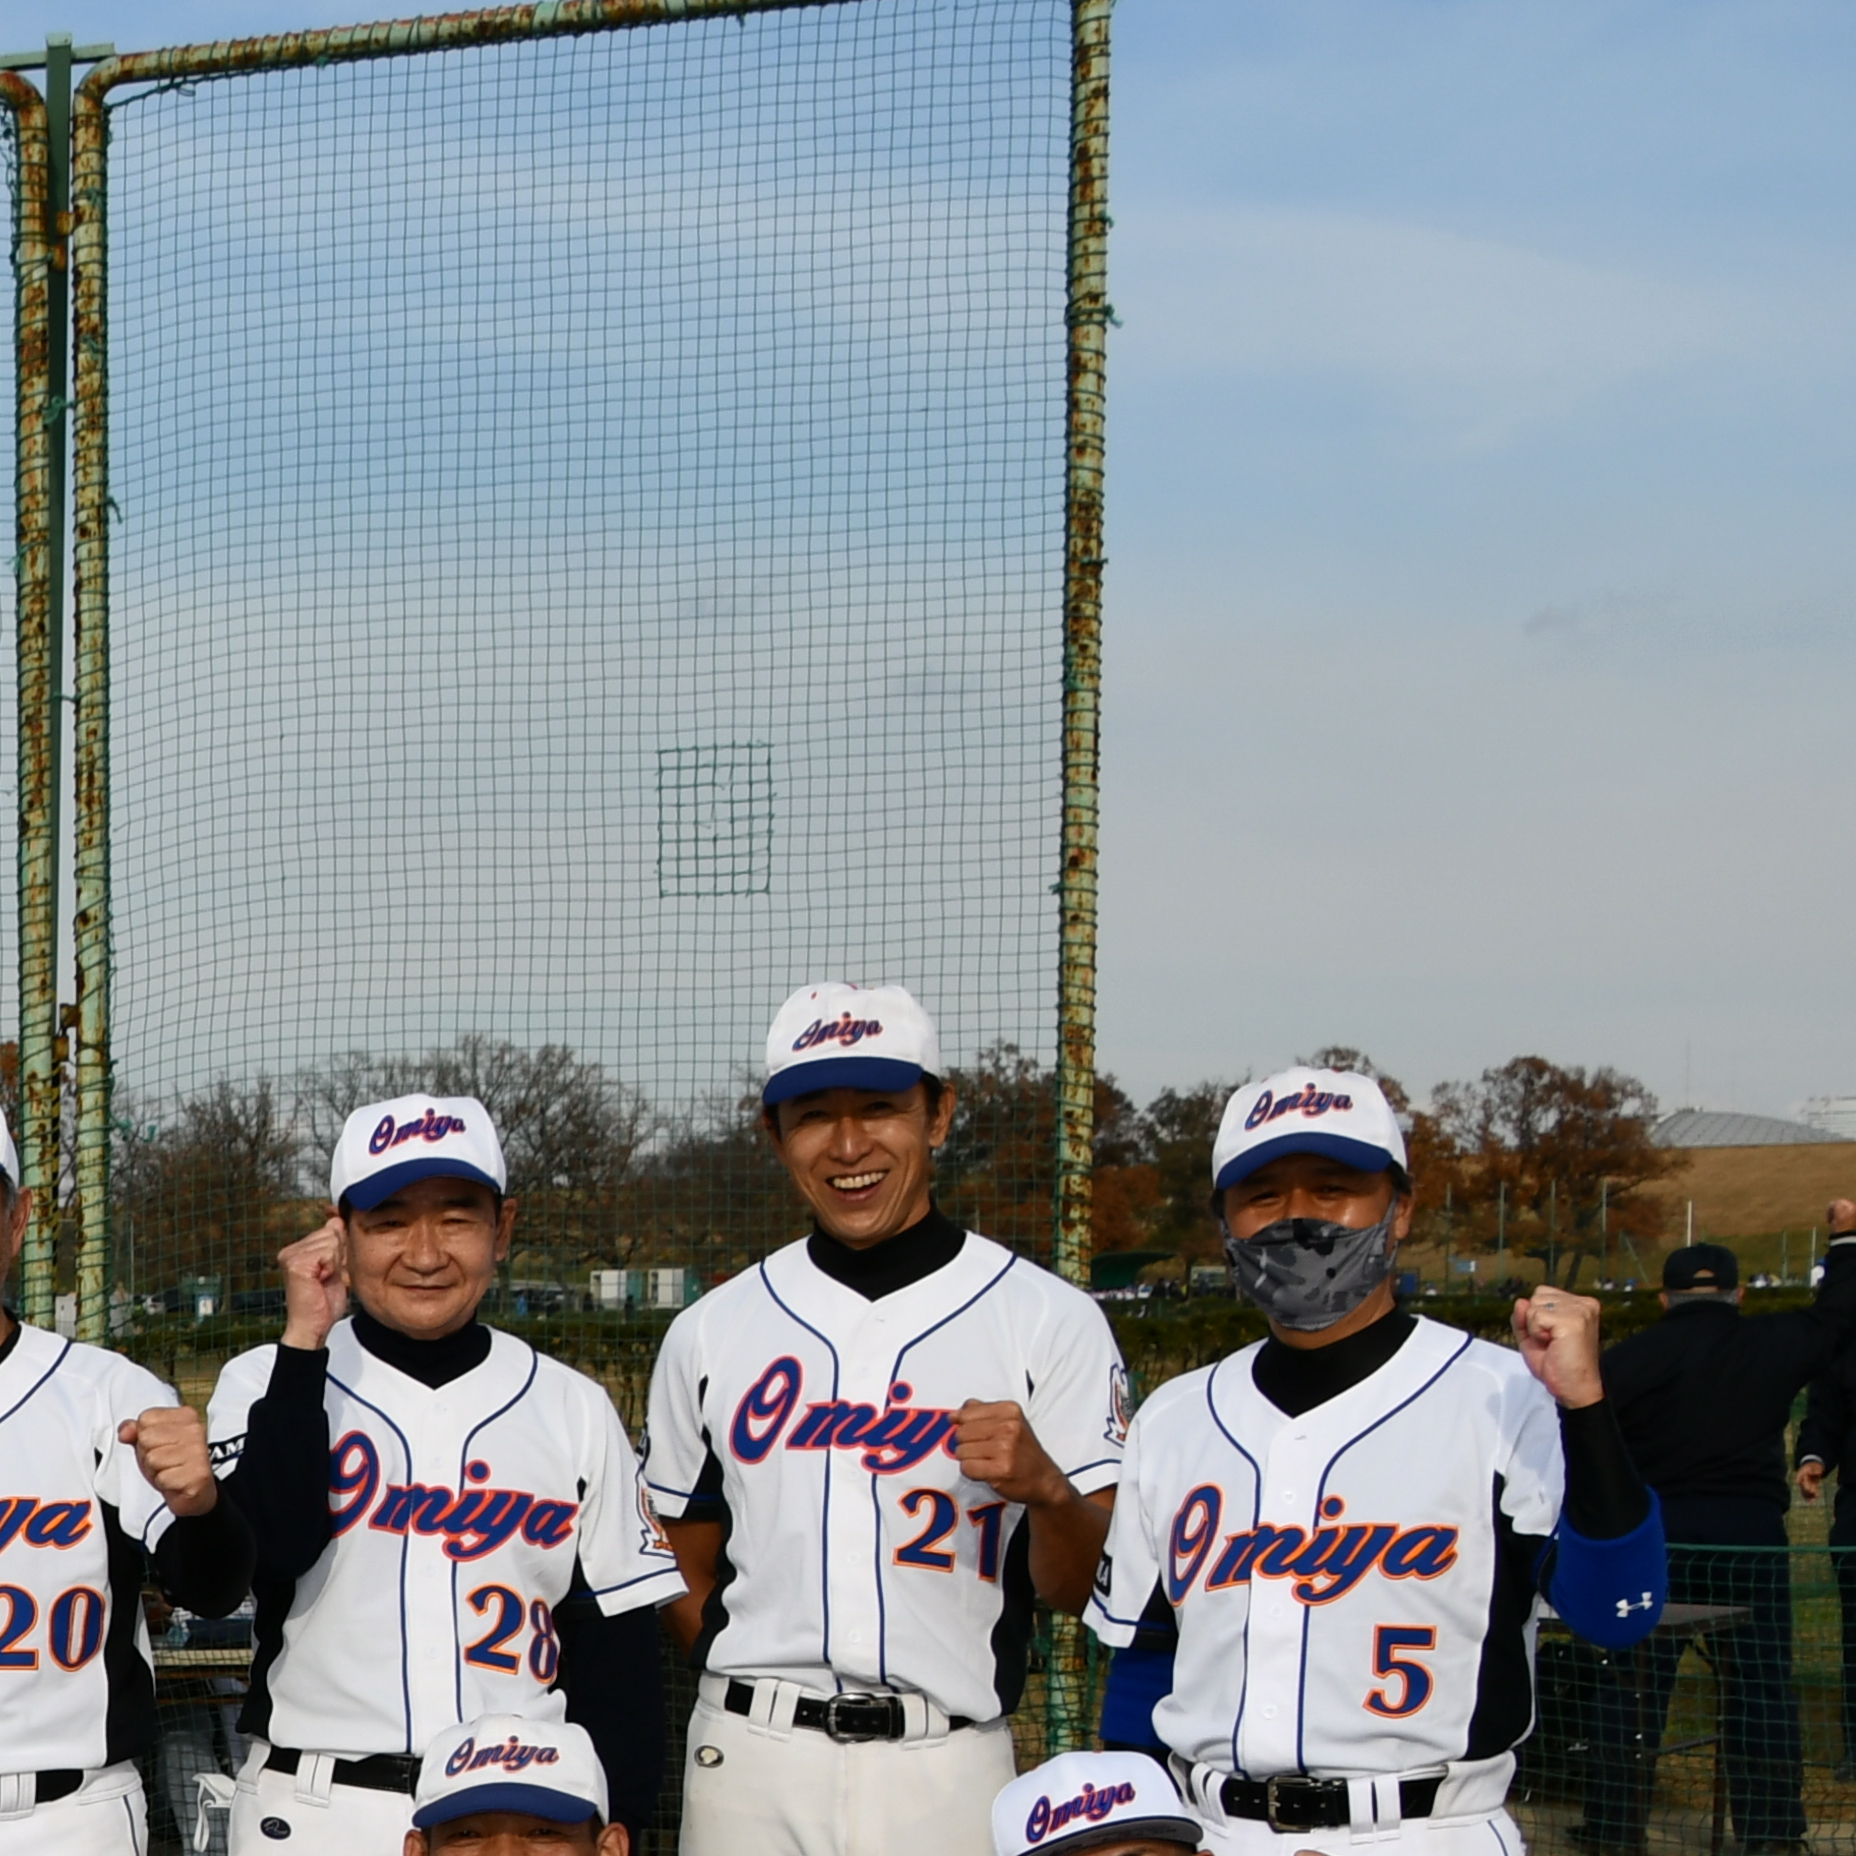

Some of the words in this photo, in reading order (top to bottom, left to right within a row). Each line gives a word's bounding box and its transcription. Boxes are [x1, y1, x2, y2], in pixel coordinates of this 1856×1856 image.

[791, 1011, 884, 1054] Omiya
[367, 1109, 466, 1156] Omiya
[1245, 1083, 1354, 1132] Omiya
[328, 1429, 579, 1562] Omiya
[892, 1486, 1006, 1583] 21
[1169, 1484, 1461, 1607] Omiya
[464, 1584, 559, 1684] 28
[1363, 1625, 1438, 1719] 5
[445, 1736, 560, 1779] Omiya
[1025, 1781, 1135, 1844] Omiya
